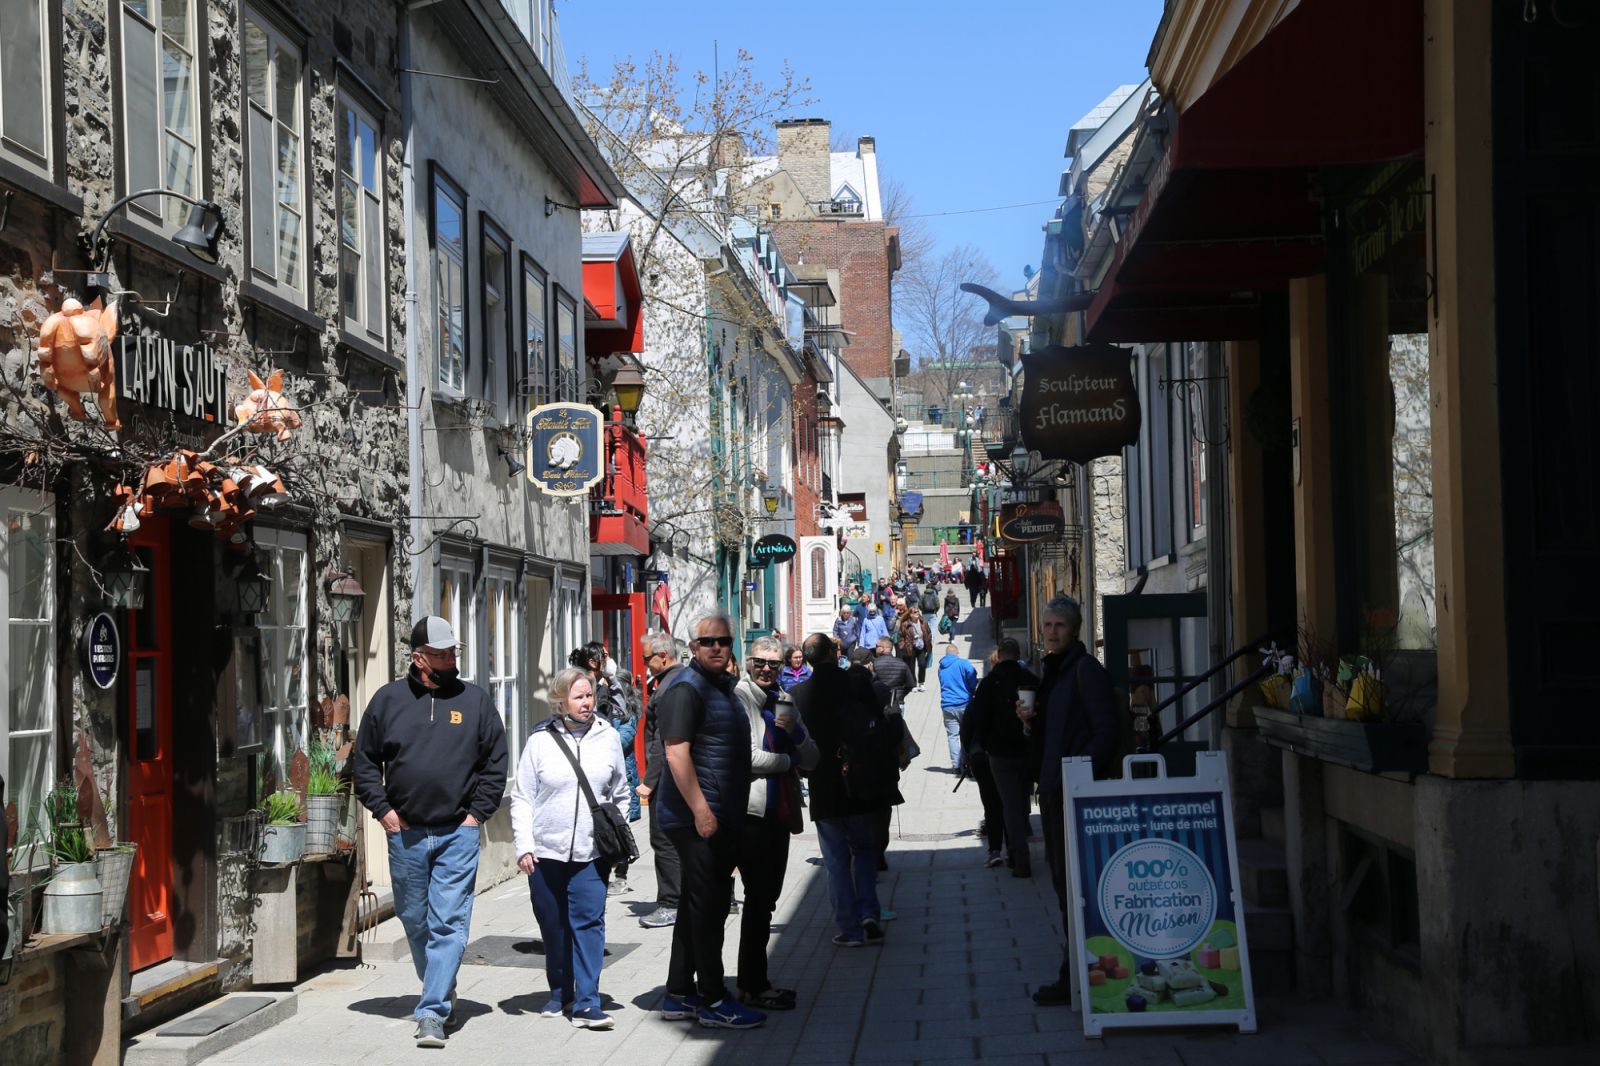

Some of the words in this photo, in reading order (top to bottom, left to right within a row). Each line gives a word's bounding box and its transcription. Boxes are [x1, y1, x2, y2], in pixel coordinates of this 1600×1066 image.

[121, 335, 176, 411] LAPIN
[1039, 374, 1117, 395] Sculpteur
[1036, 399, 1126, 429] Flamand
[449, 709, 463, 725] B
[1083, 802, 1138, 821] nougat
[1152, 799, 1216, 817] caramel
[1085, 822, 1140, 836] guimauve
[1150, 821, 1174, 832] lune
[1176, 819, 1190, 830] de
[1193, 817, 1217, 829] miel
[1124, 858, 1188, 879] 100%
[1128, 878, 1189, 892] QUÉBÉCOIS
[1114, 892, 1202, 909] Fabrication
[1119, 910, 1201, 938] Maison
